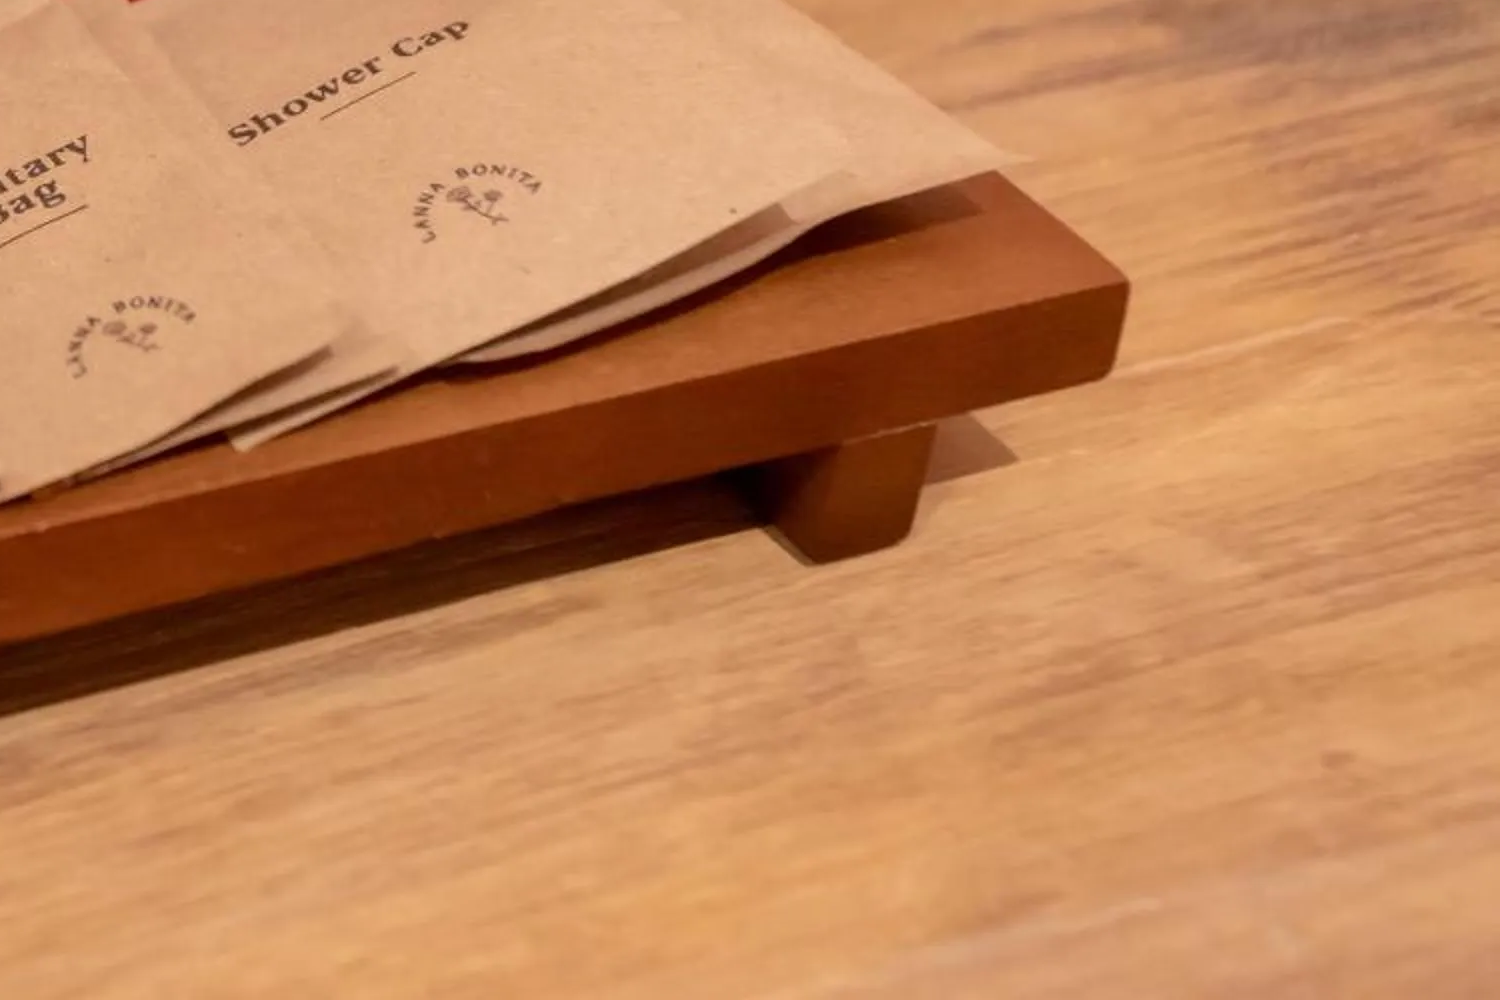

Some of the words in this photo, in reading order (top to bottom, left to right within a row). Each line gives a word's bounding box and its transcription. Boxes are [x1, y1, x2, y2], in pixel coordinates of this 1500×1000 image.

[227, 55, 384, 147] Shower
[390, 19, 470, 57] Cap
[454, 163, 544, 195] BONITA
[111, 295, 198, 326] BONITA
